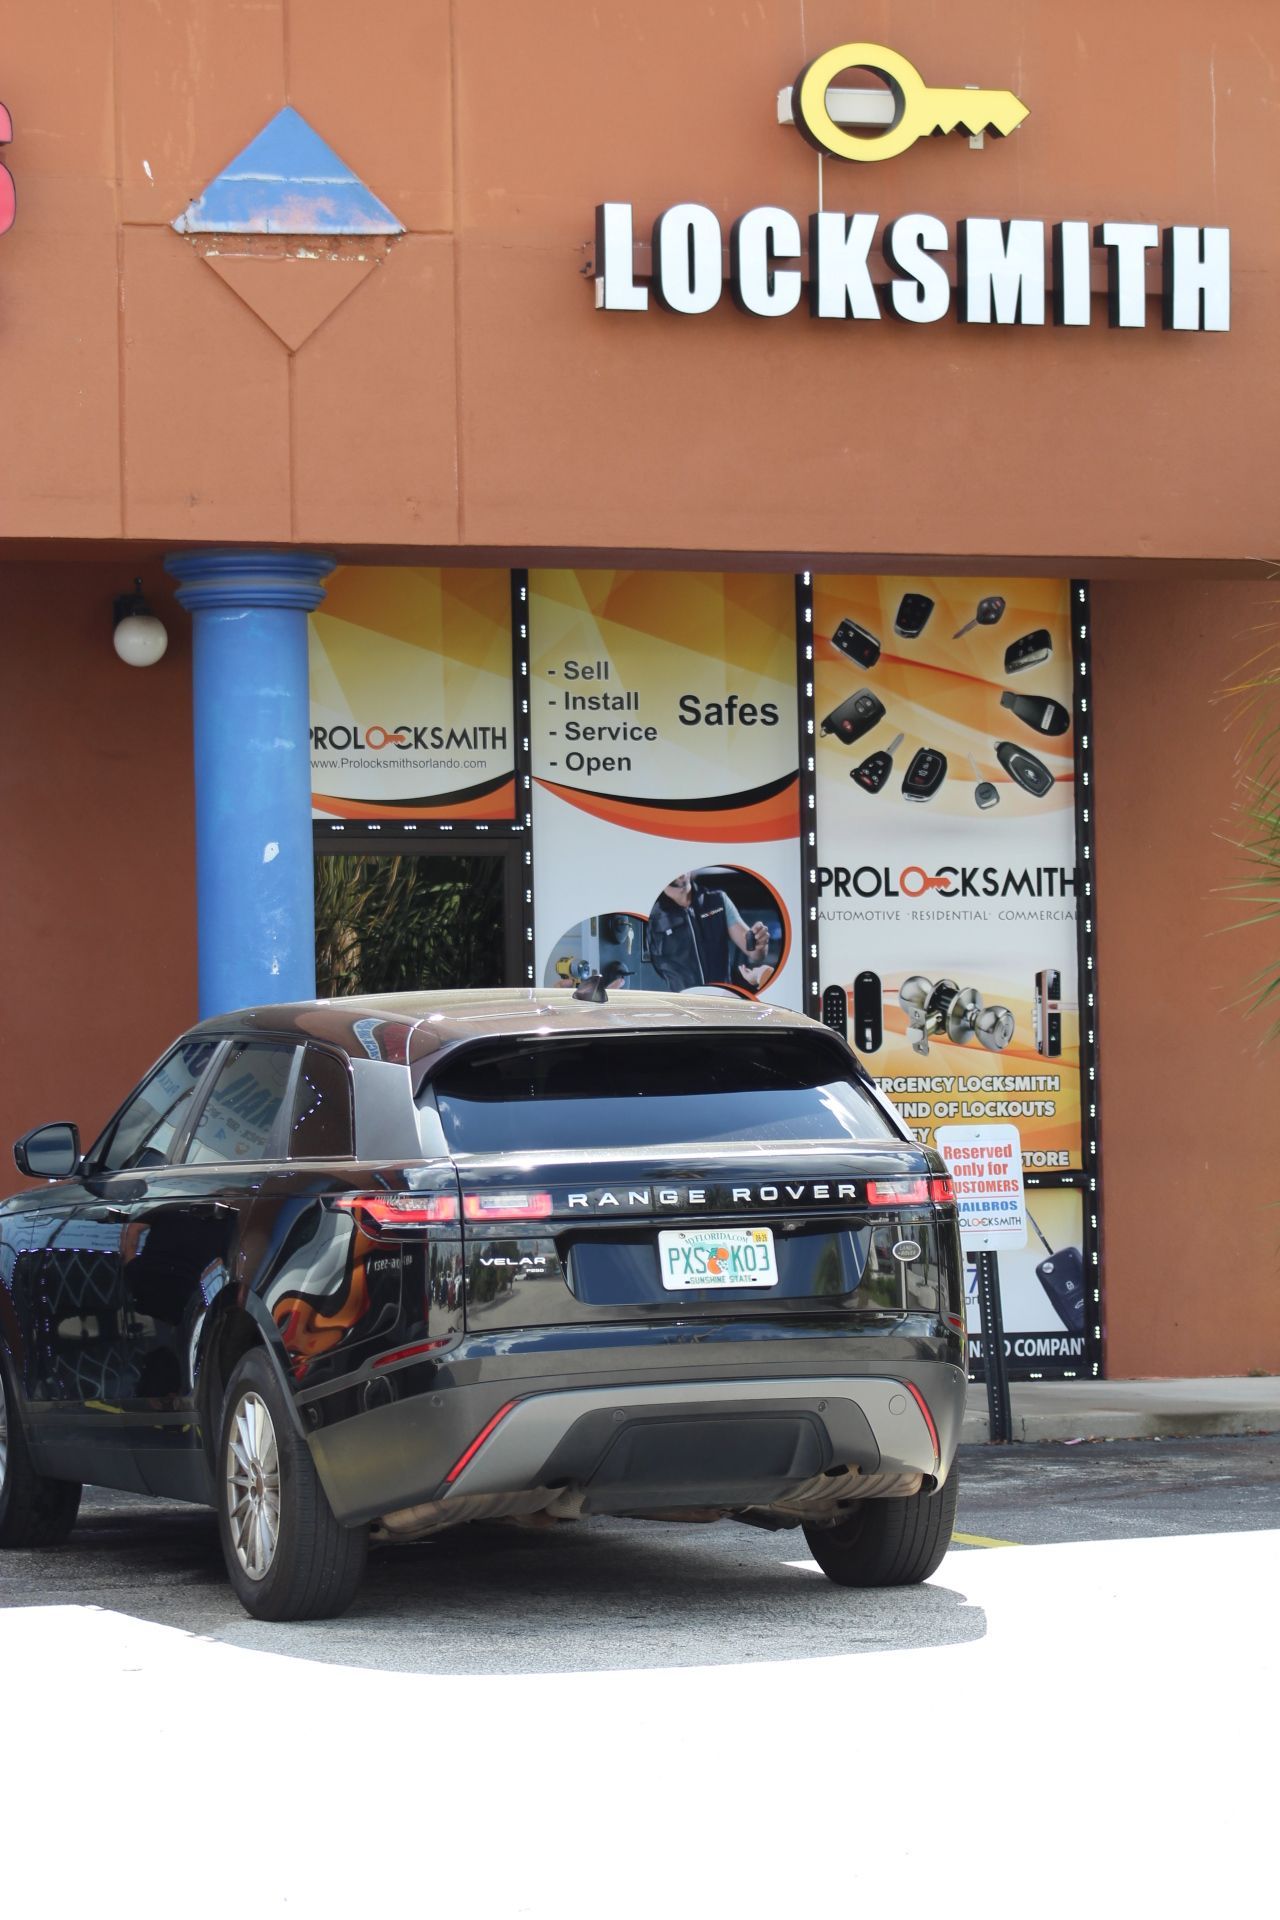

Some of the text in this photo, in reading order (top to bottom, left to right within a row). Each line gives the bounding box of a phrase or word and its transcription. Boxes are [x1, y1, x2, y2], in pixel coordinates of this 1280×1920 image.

[600, 202, 1231, 332] LOCKSMITH
[564, 660, 609, 680] Sell
[564, 691, 639, 711] Install
[678, 694, 780, 726] Safes
[310, 726, 506, 750] ROLOCKSMITH
[565, 721, 658, 741] Service
[311, 758, 487, 769] www.Prolocksmithsorlando.com
[565, 751, 631, 776] Open
[818, 866, 1078, 897] PROLOCKSMITH
[818, 910, 900, 921] AUTOMOTIVE
[957, 1075, 1060, 1092] LOCKSMITH
[896, 1101, 1056, 1118] IND OF LOCKOUTS
[943, 1144, 1012, 1160] Reserved
[954, 1162, 1008, 1177] only for
[568, 1184, 856, 1207] RANGE ROVER
[953, 1180, 1019, 1194] USTOMERS
[480, 1257, 546, 1265] VELAR
[668, 1247, 707, 1274] PXS
[690, 1275, 752, 1285] SUNSHINE STATE
